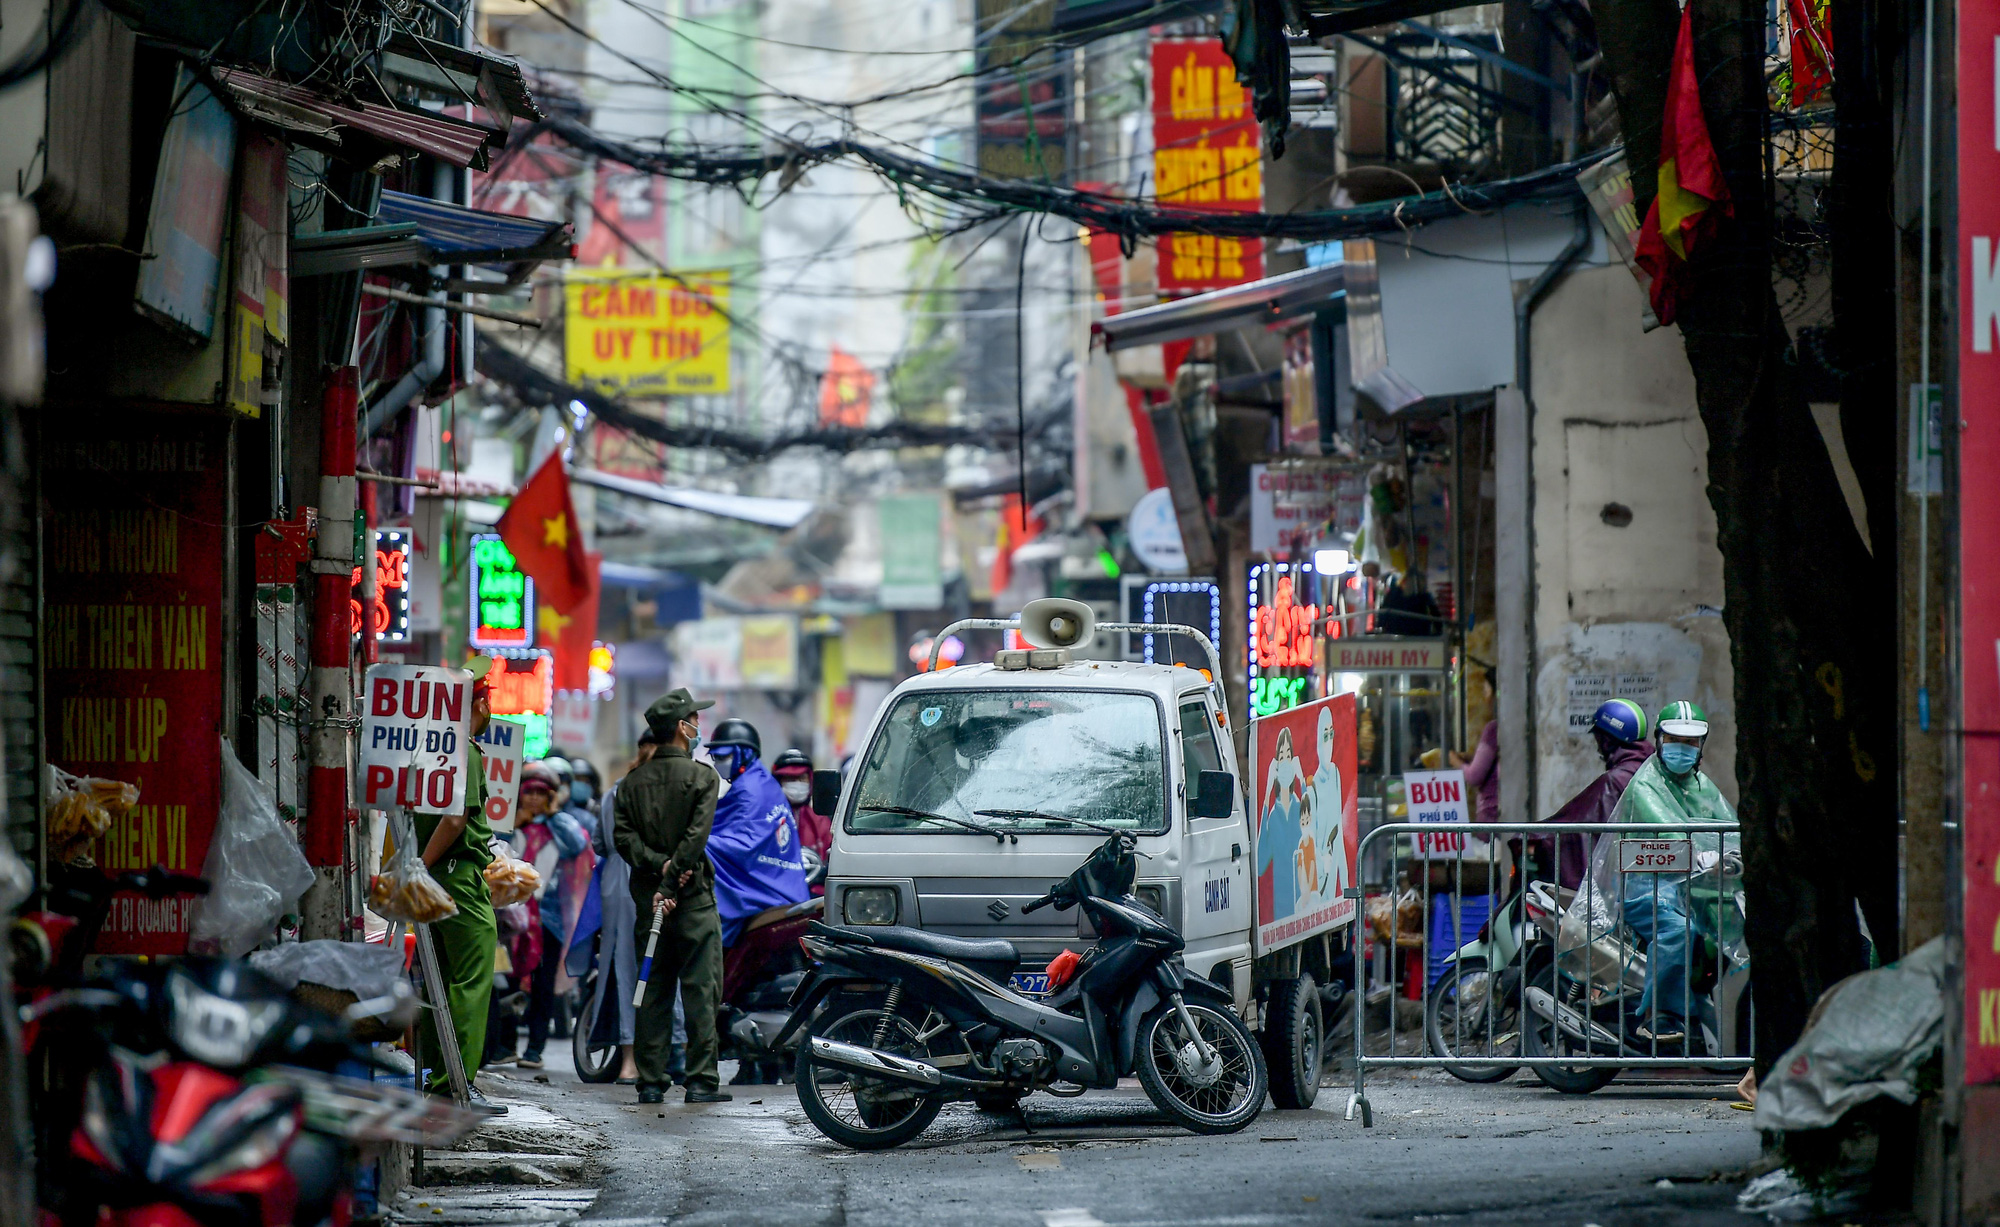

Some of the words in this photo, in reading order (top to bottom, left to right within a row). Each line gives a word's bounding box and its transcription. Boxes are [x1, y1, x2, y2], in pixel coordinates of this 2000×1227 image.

[593, 328, 635, 360] UY
[87, 590, 153, 670] THIÊN
[160, 590, 206, 670] VĂN
[371, 672, 463, 722] BÚN
[62, 683, 117, 762] KÍNH
[125, 683, 167, 763] LÚP
[372, 724, 418, 751] PHÚ
[426, 727, 457, 754] ĐÔ
[365, 755, 457, 808] PHỞ
[1411, 776, 1460, 804] BÚN
[1419, 809, 1441, 822] PHÚ
[1444, 808, 1458, 822] ĐÔ
[165, 804, 187, 869] VI
[1635, 854, 1676, 866] STOP
[1220, 870, 1230, 911] SÁT
[122, 898, 133, 940] BỊ
[137, 898, 177, 933] QUANG
[1135, 940, 1157, 948] HONDA
